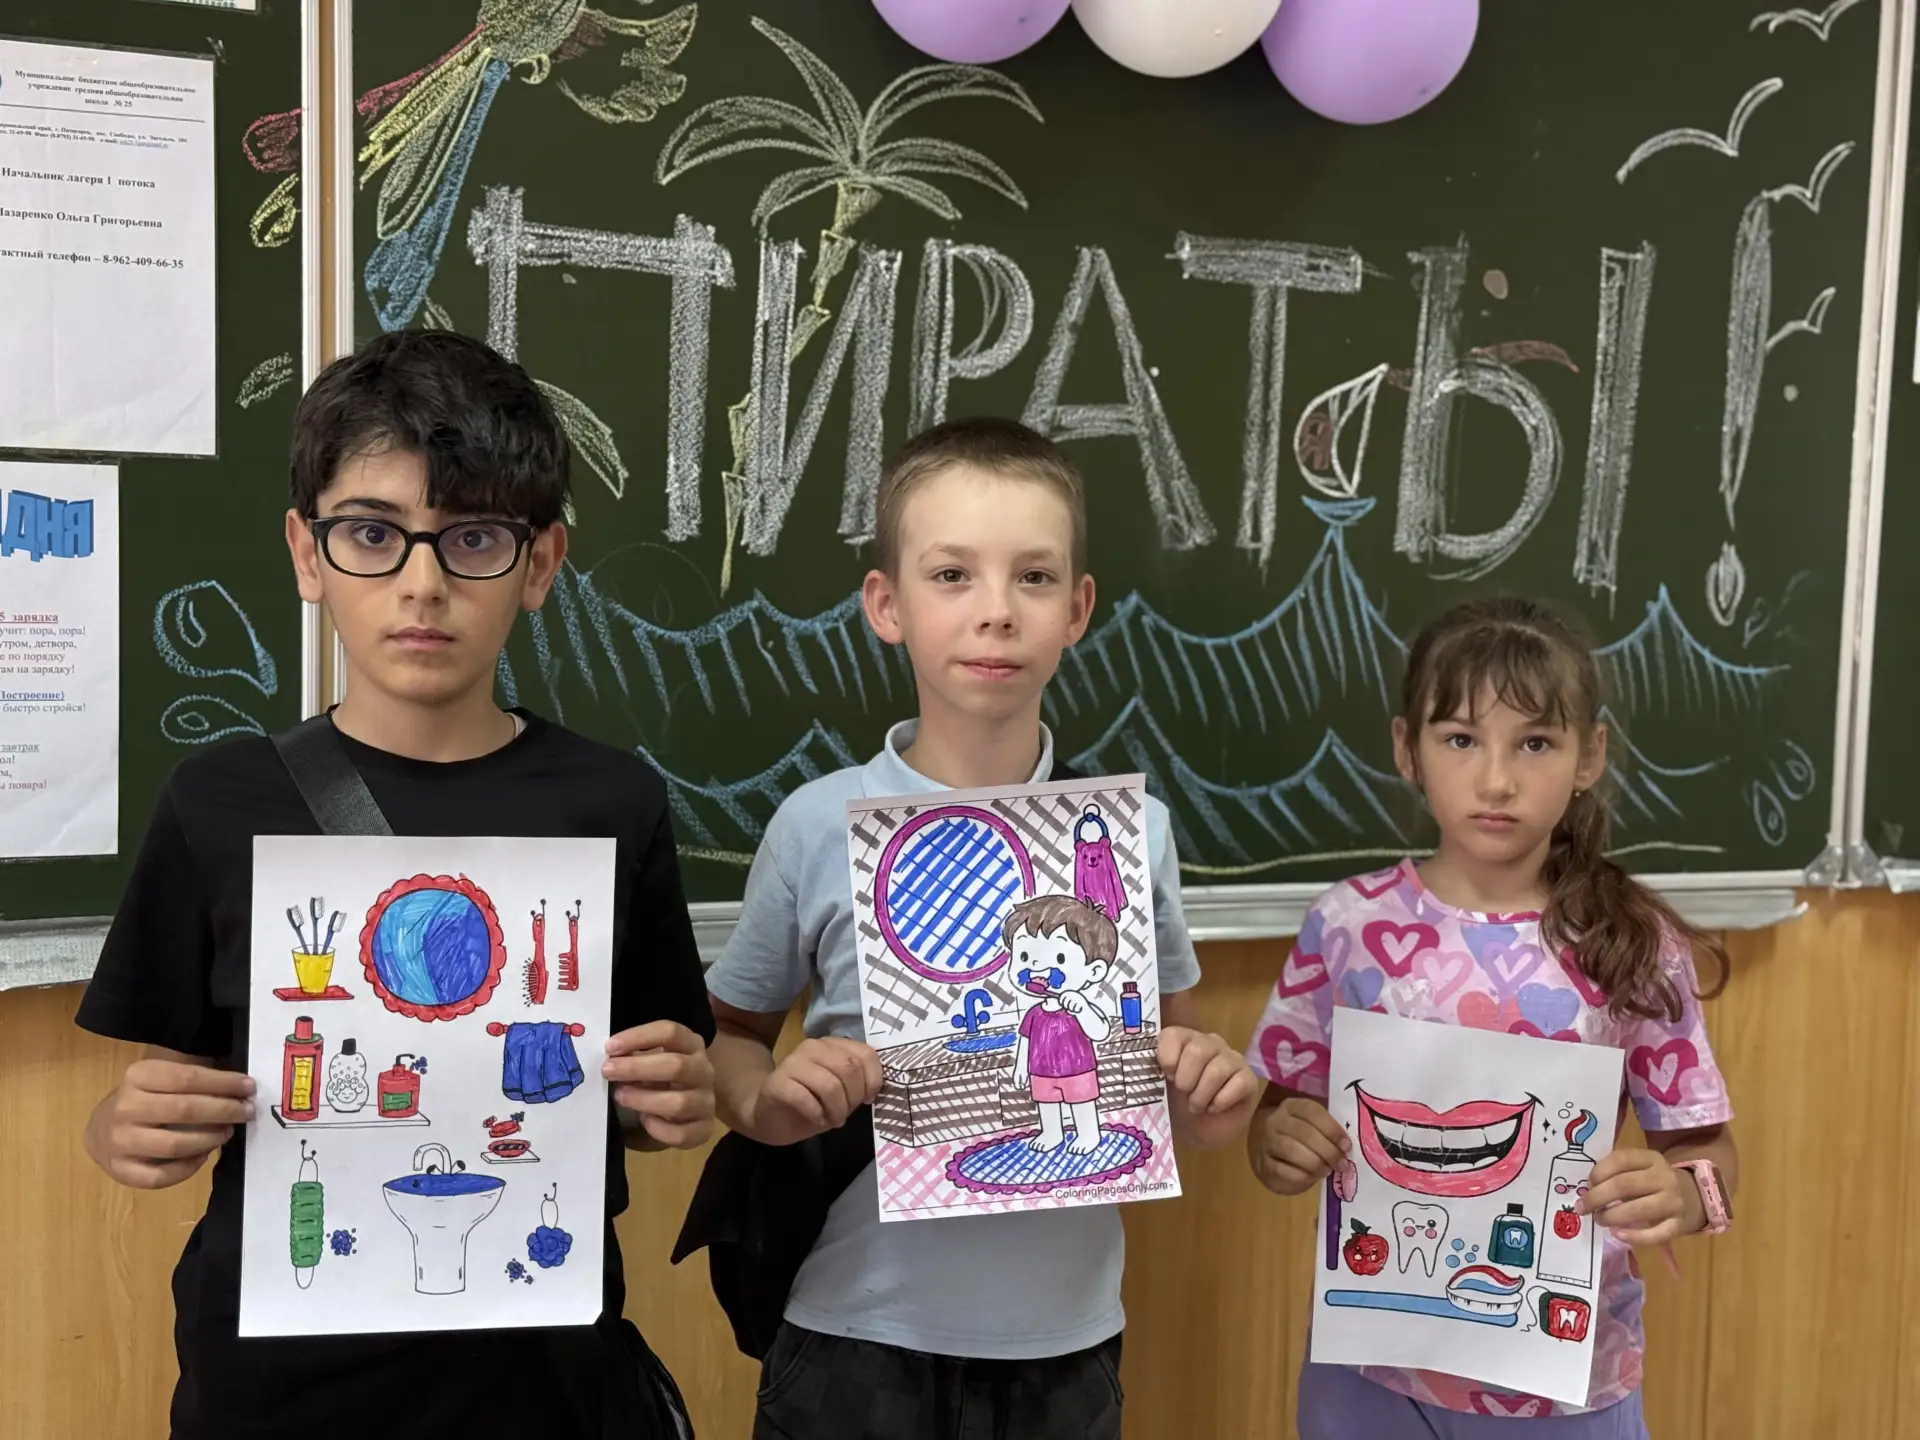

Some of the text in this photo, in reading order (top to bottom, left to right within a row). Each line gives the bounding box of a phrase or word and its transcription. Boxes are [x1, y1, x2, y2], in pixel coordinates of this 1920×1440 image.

[124, 100, 133, 108] 25
[2, 167, 156, 189] Начальник лагеря 1 потока
[56, 211, 90, 223] Ольга
[93, 214, 163, 228] Григорьевна
[46, 251, 91, 264] телефон
[103, 254, 184, 268] 8-962-409-66-35
[1, 489, 94, 562] ДНЯ
[11, 613, 59, 624] зарядка
[29, 627, 56, 637] пора,
[59, 625, 86, 637] пора!
[33, 640, 77, 650] детвора,
[8, 653, 21, 661] по
[23, 653, 66, 663] порядку
[17, 666, 29, 674] на
[31, 664, 75, 676] зарядку!
[2, 702, 86, 714] быстро стройся!
[1, 743, 40, 754] завтрак
[8, 779, 47, 791] повара!
[1055, 1181, 1168, 1198] ColoringPagesOnly.com
